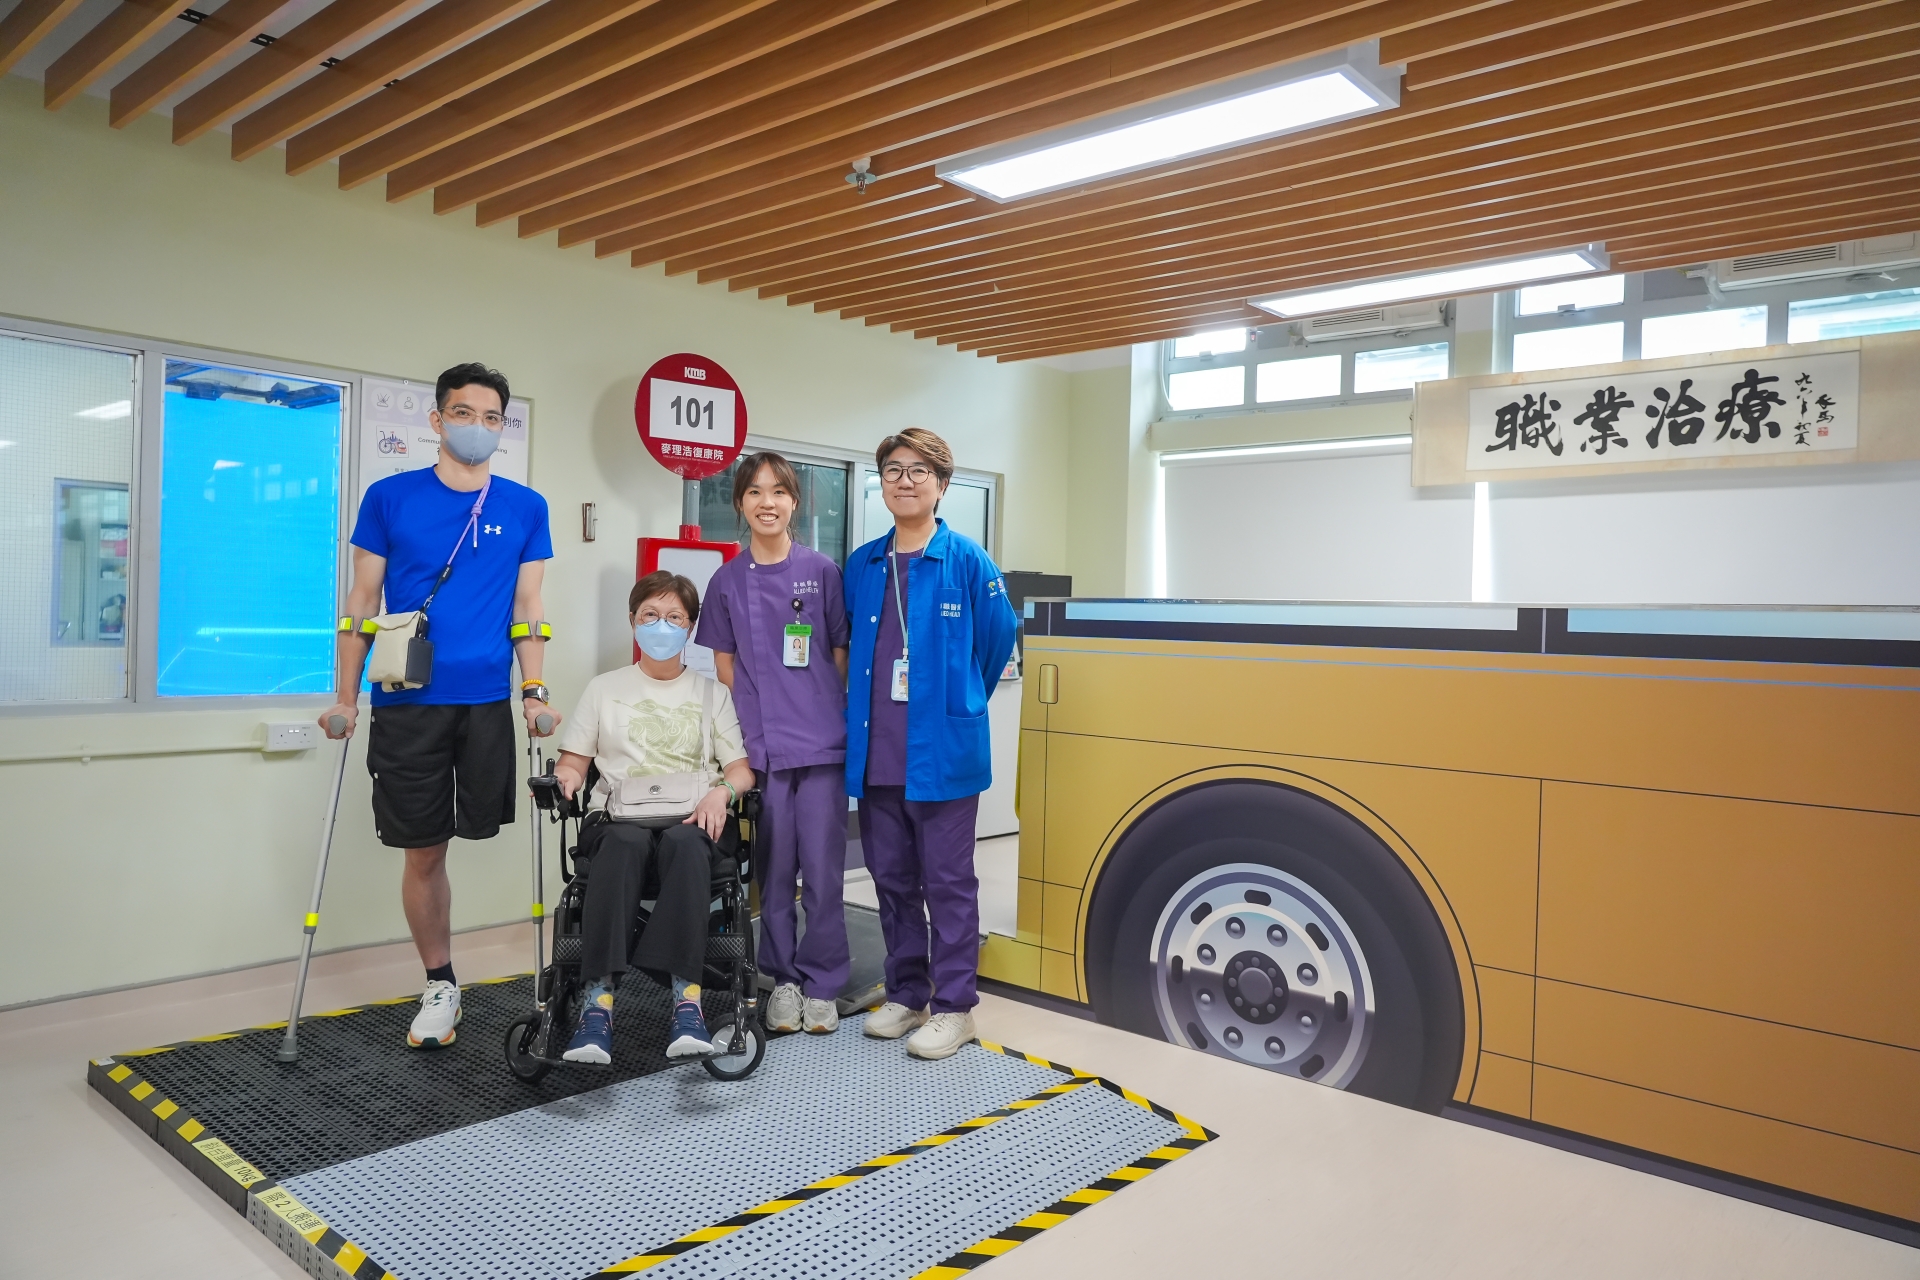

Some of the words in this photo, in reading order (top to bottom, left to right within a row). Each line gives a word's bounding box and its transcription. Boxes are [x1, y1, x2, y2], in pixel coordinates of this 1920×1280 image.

[670, 395, 714, 430] 101
[1484, 368, 1787, 457] 職業治療
[417, 436, 441, 445] Commu
[661, 443, 724, 461] 麥理浩復康院
